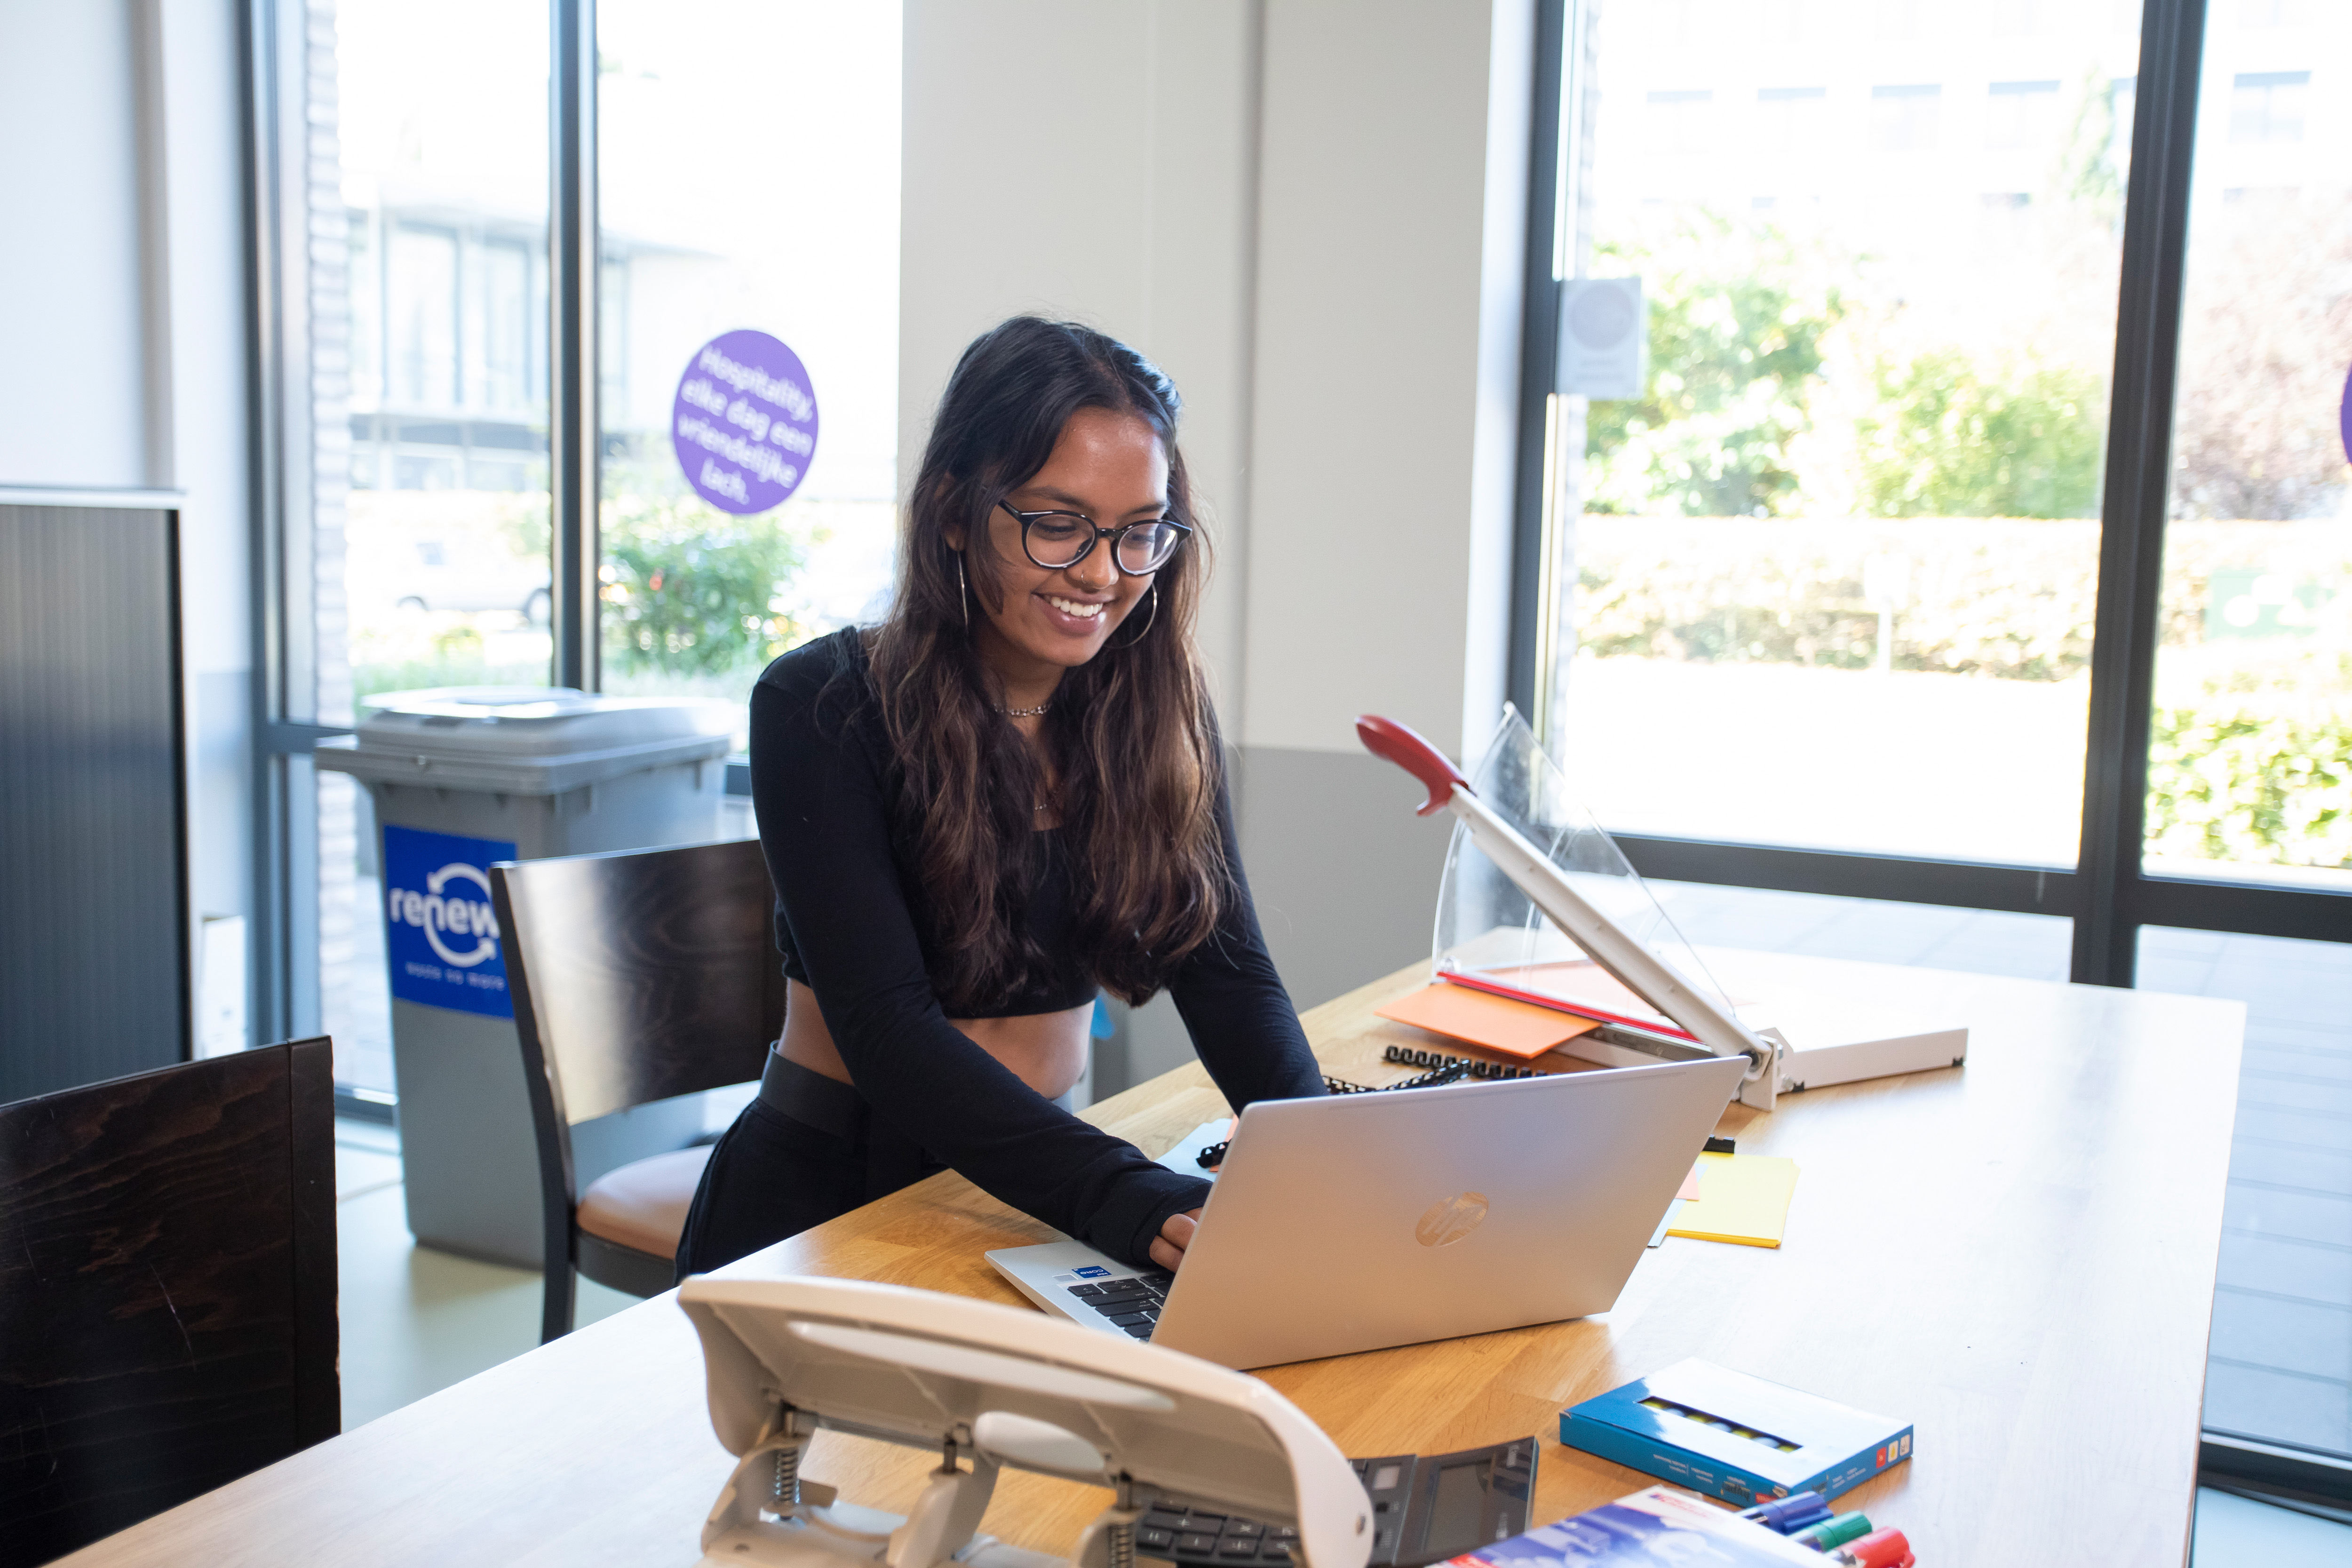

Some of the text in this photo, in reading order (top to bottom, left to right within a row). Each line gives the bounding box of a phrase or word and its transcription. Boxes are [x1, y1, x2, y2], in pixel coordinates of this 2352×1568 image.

[682, 379, 813, 457] elke dag een
